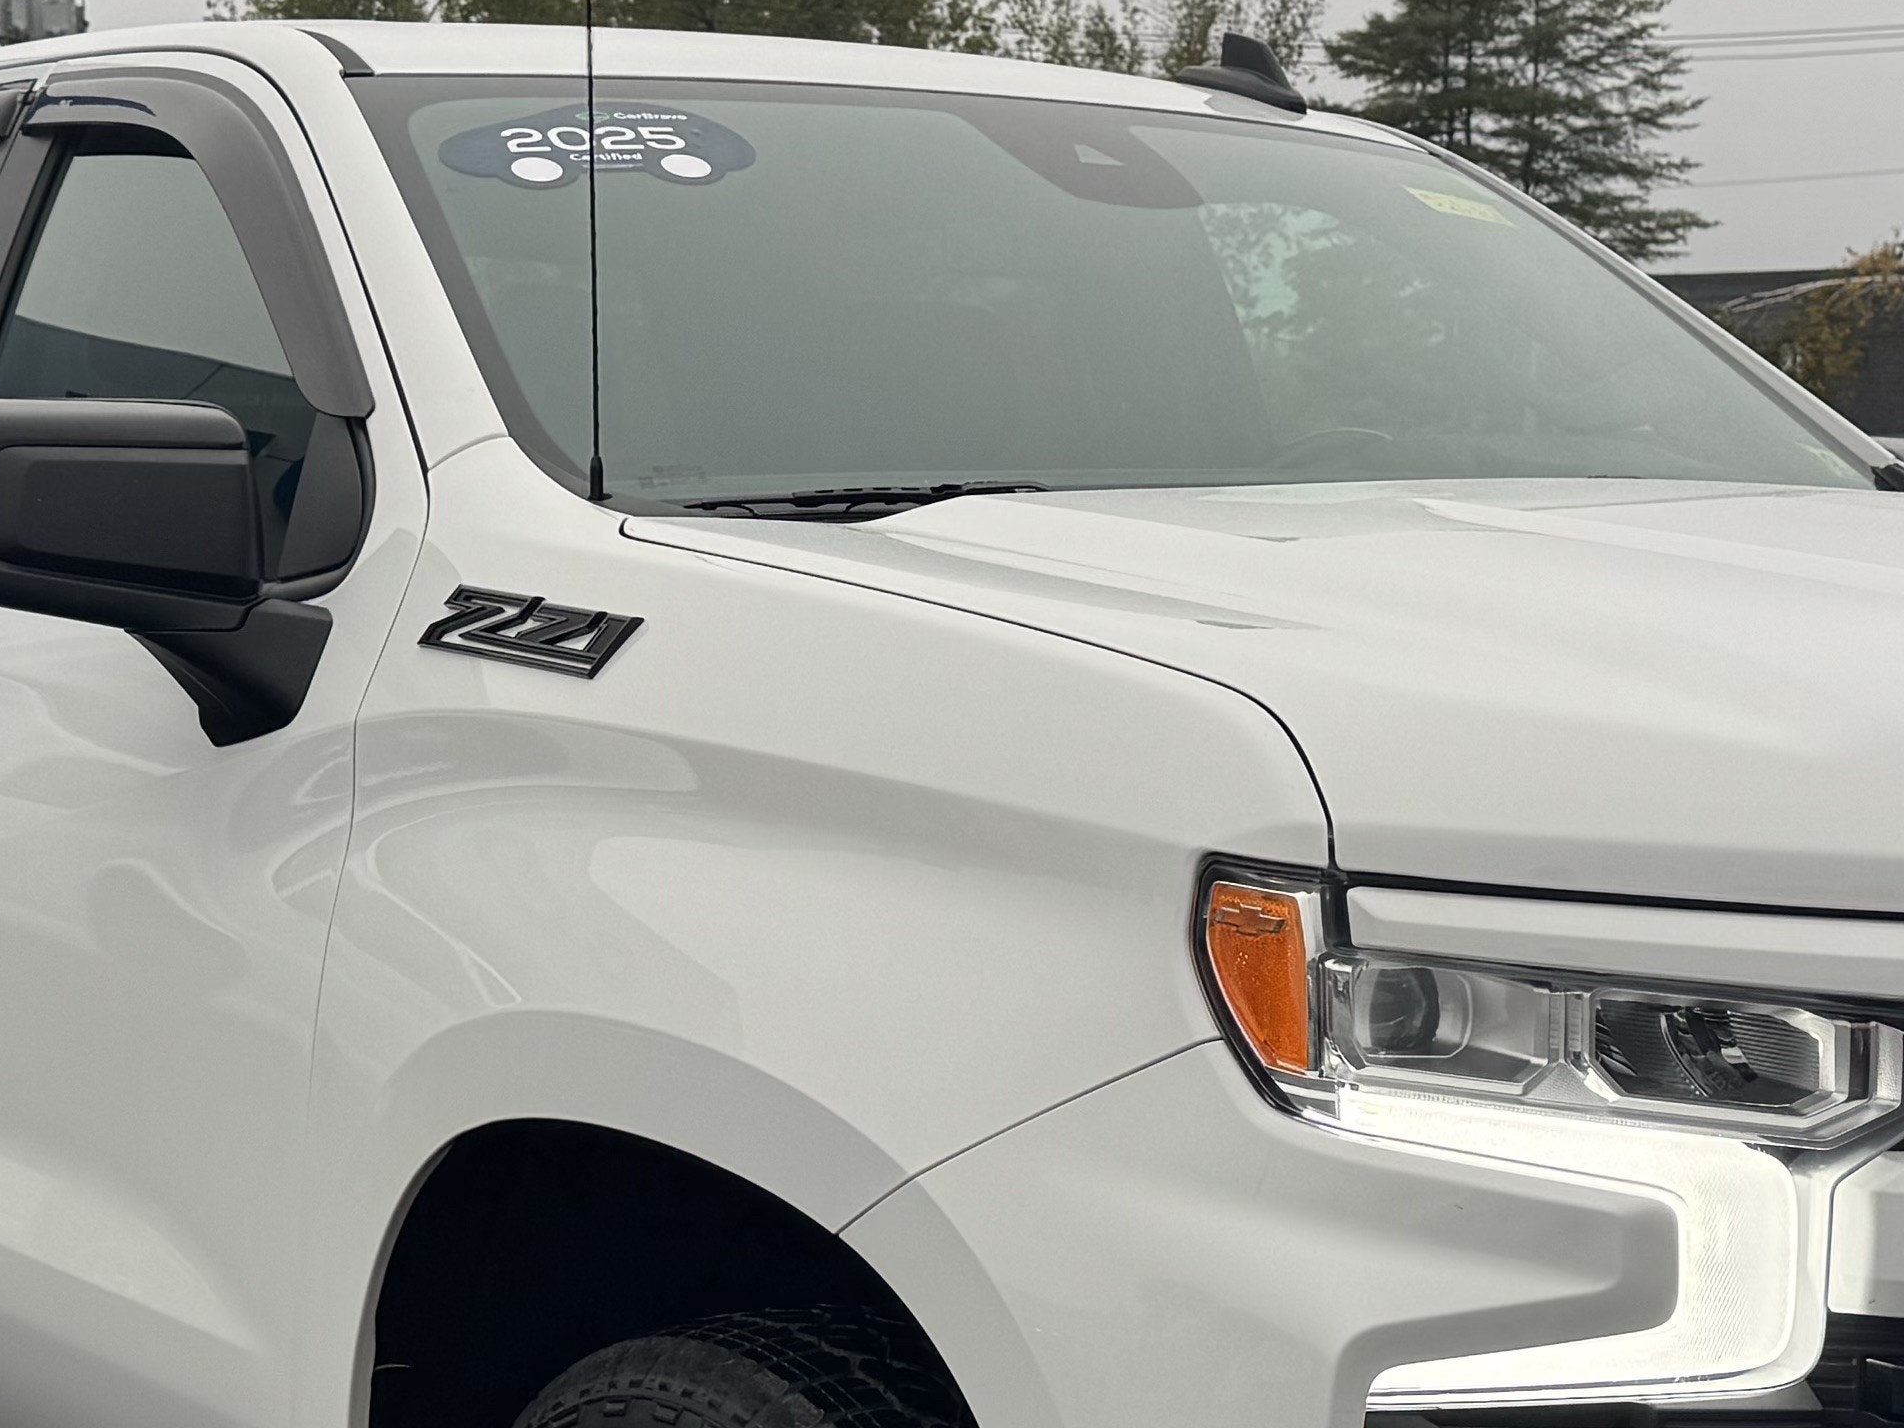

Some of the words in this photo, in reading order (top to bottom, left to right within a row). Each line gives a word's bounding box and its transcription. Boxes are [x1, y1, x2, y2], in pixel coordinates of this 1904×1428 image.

[500, 126, 686, 153] 2025
[569, 152, 643, 162] Certified
[417, 584, 645, 679] Z71
